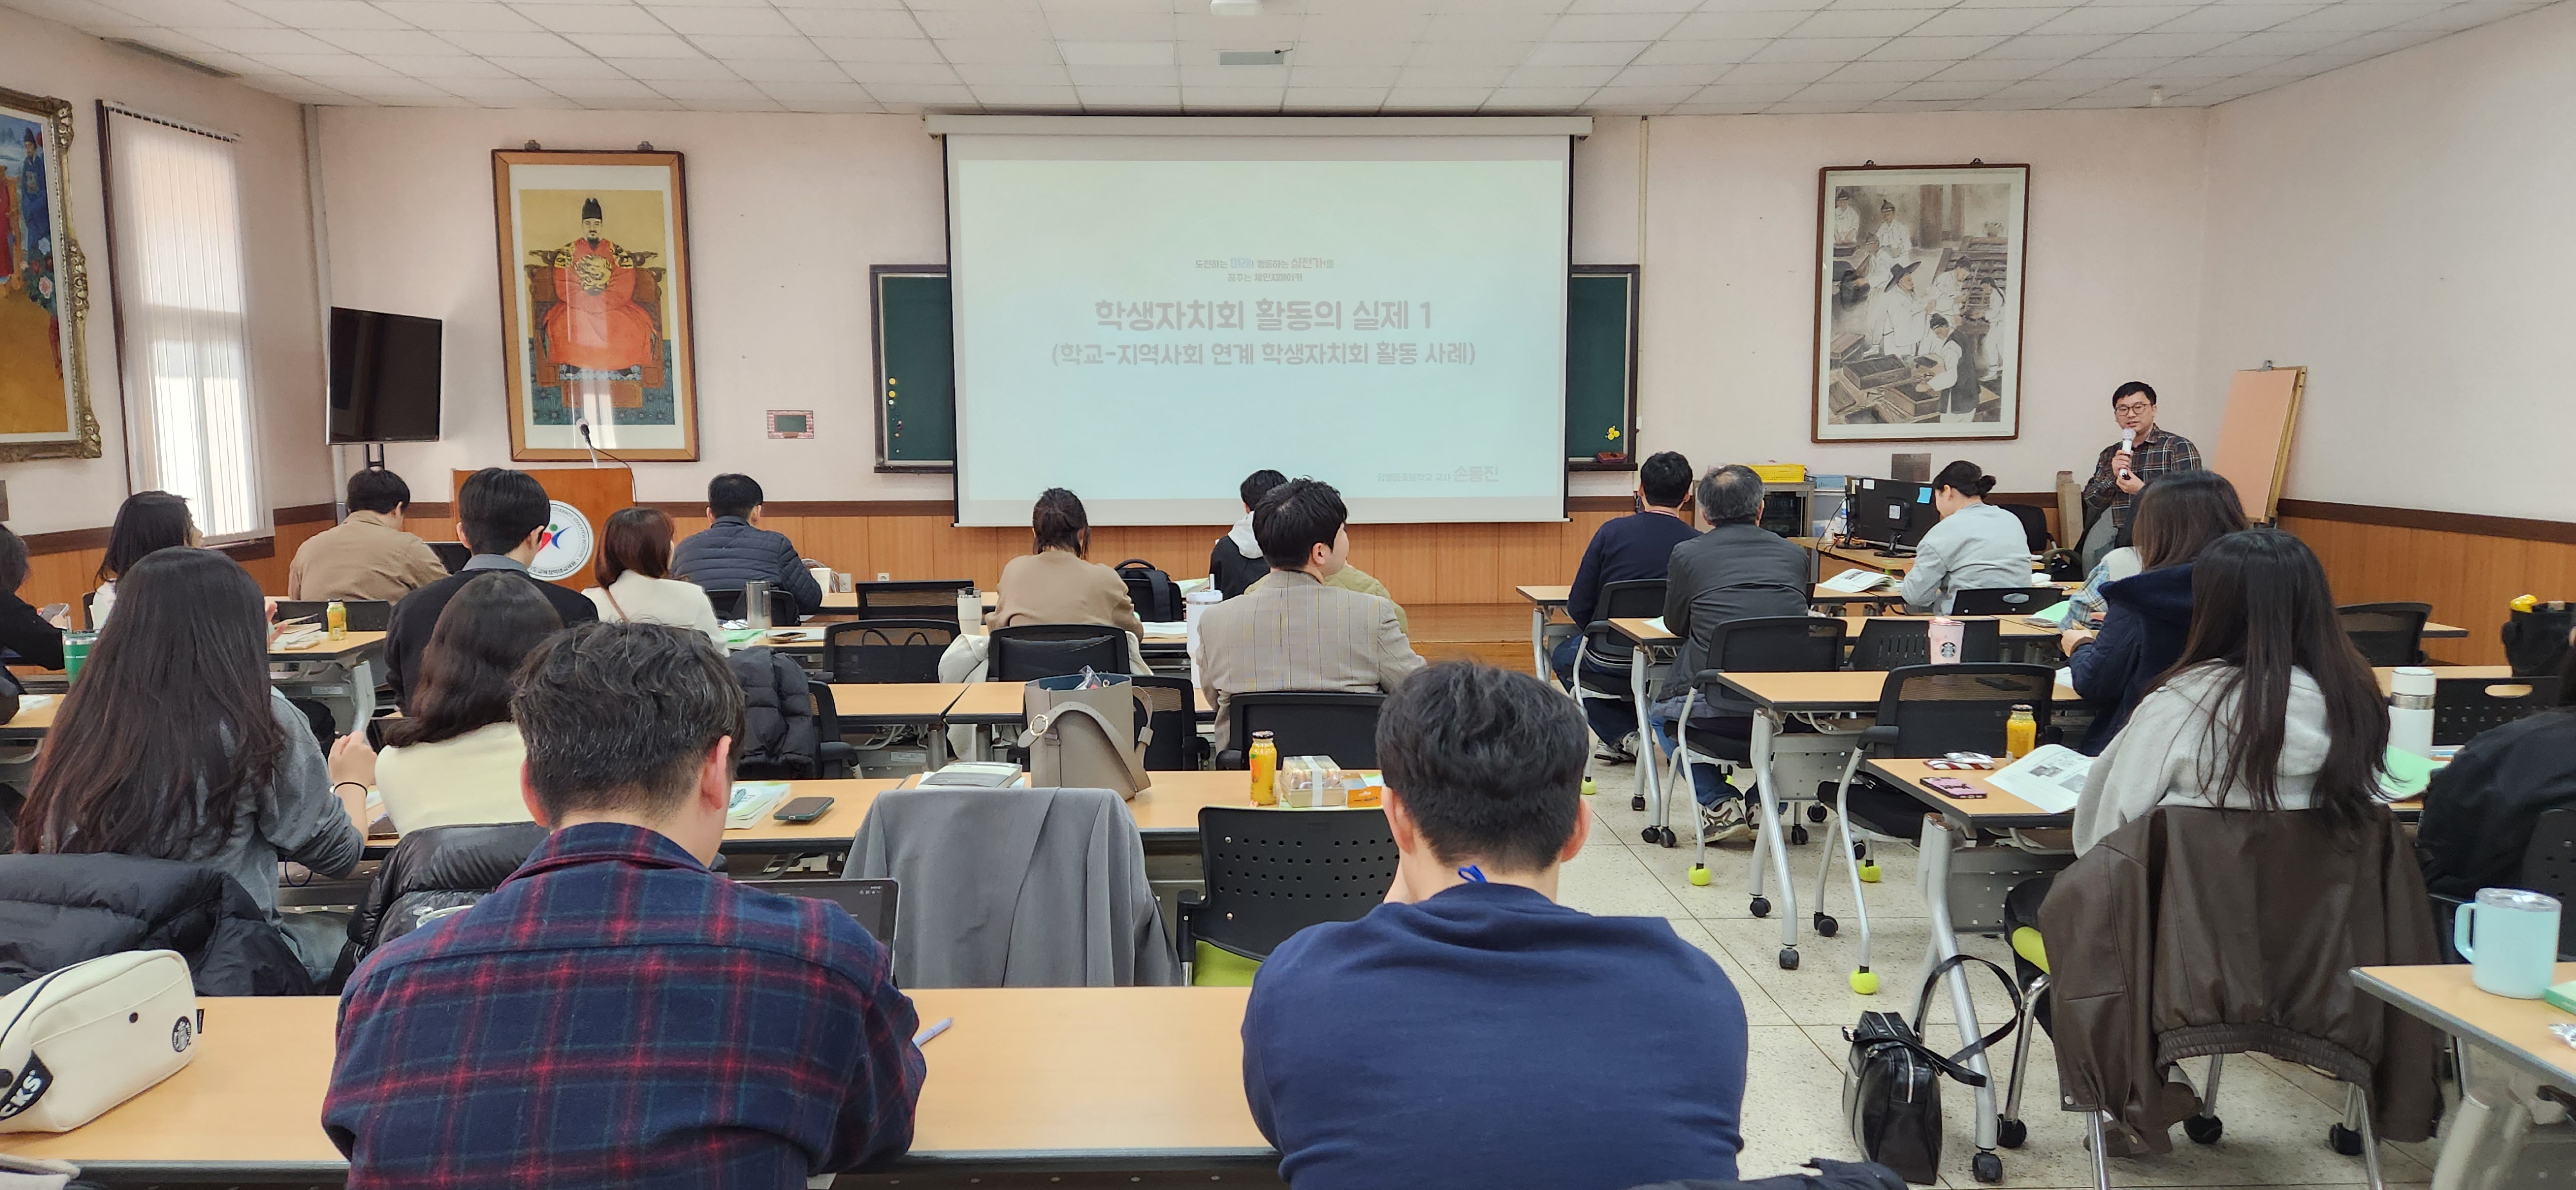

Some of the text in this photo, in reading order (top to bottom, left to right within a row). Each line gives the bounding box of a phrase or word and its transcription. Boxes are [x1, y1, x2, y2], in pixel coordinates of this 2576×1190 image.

[1095, 298, 1432, 331] 학생자치회 활동의 실제 1
[1051, 341, 1476, 366] (학교-지역사회 연계 학생자치회 활동 사례)
[1453, 465, 1499, 483] 손동진
